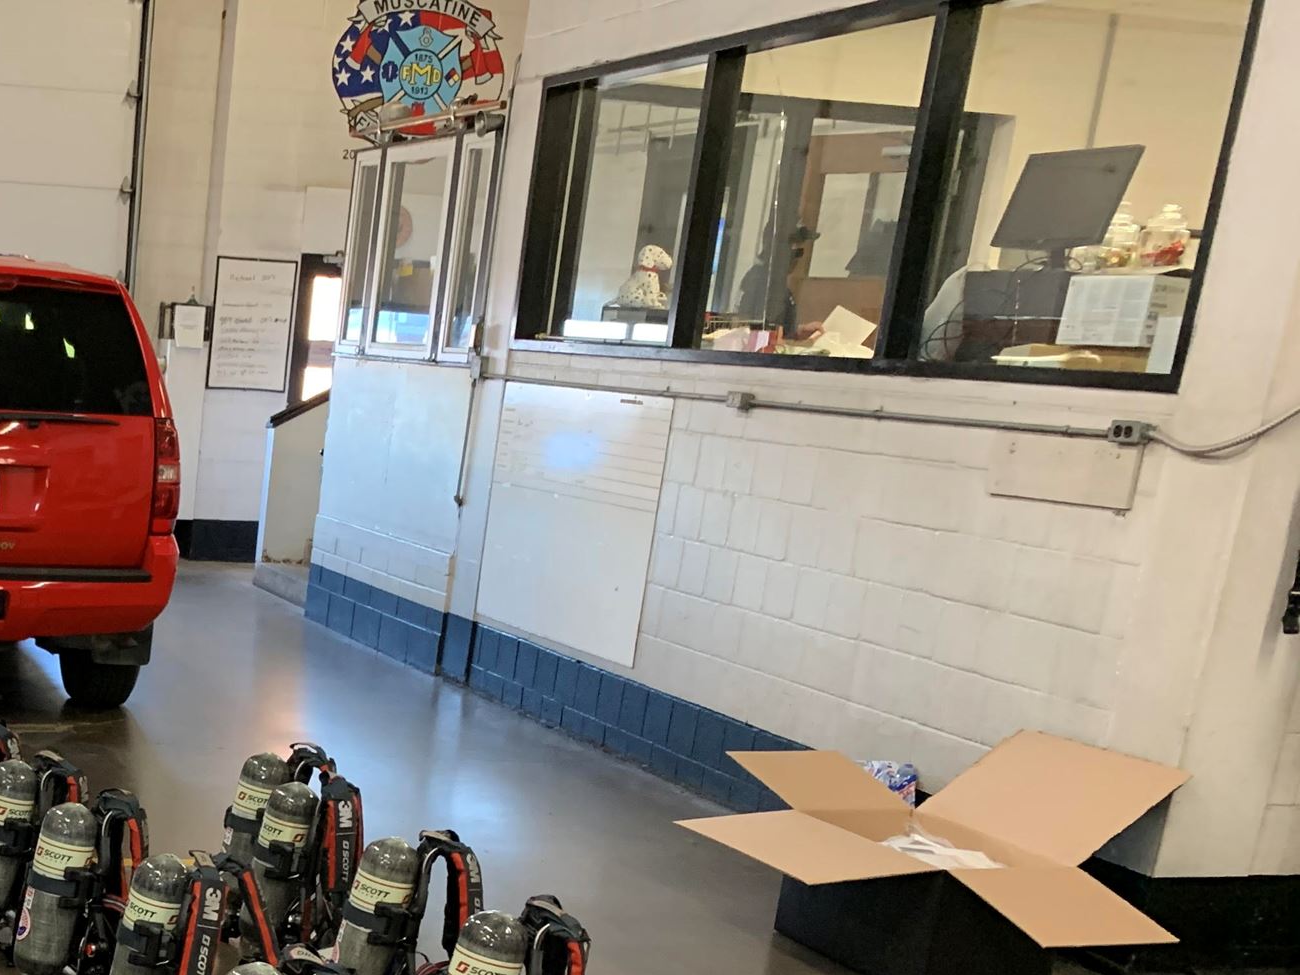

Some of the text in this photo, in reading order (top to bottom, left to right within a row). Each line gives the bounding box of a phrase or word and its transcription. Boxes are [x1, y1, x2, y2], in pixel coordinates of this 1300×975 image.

[374, 0, 482, 28] MUSCATINE
[414, 53, 433, 63] 1875
[337, 800, 353, 830] 3M
[43, 848, 74, 863] SCOTT
[342, 850, 350, 882] SCOTT
[360, 882, 391, 898] SCOTT
[129, 902, 157, 919] SCOTT
[202, 887, 222, 921] 3M
